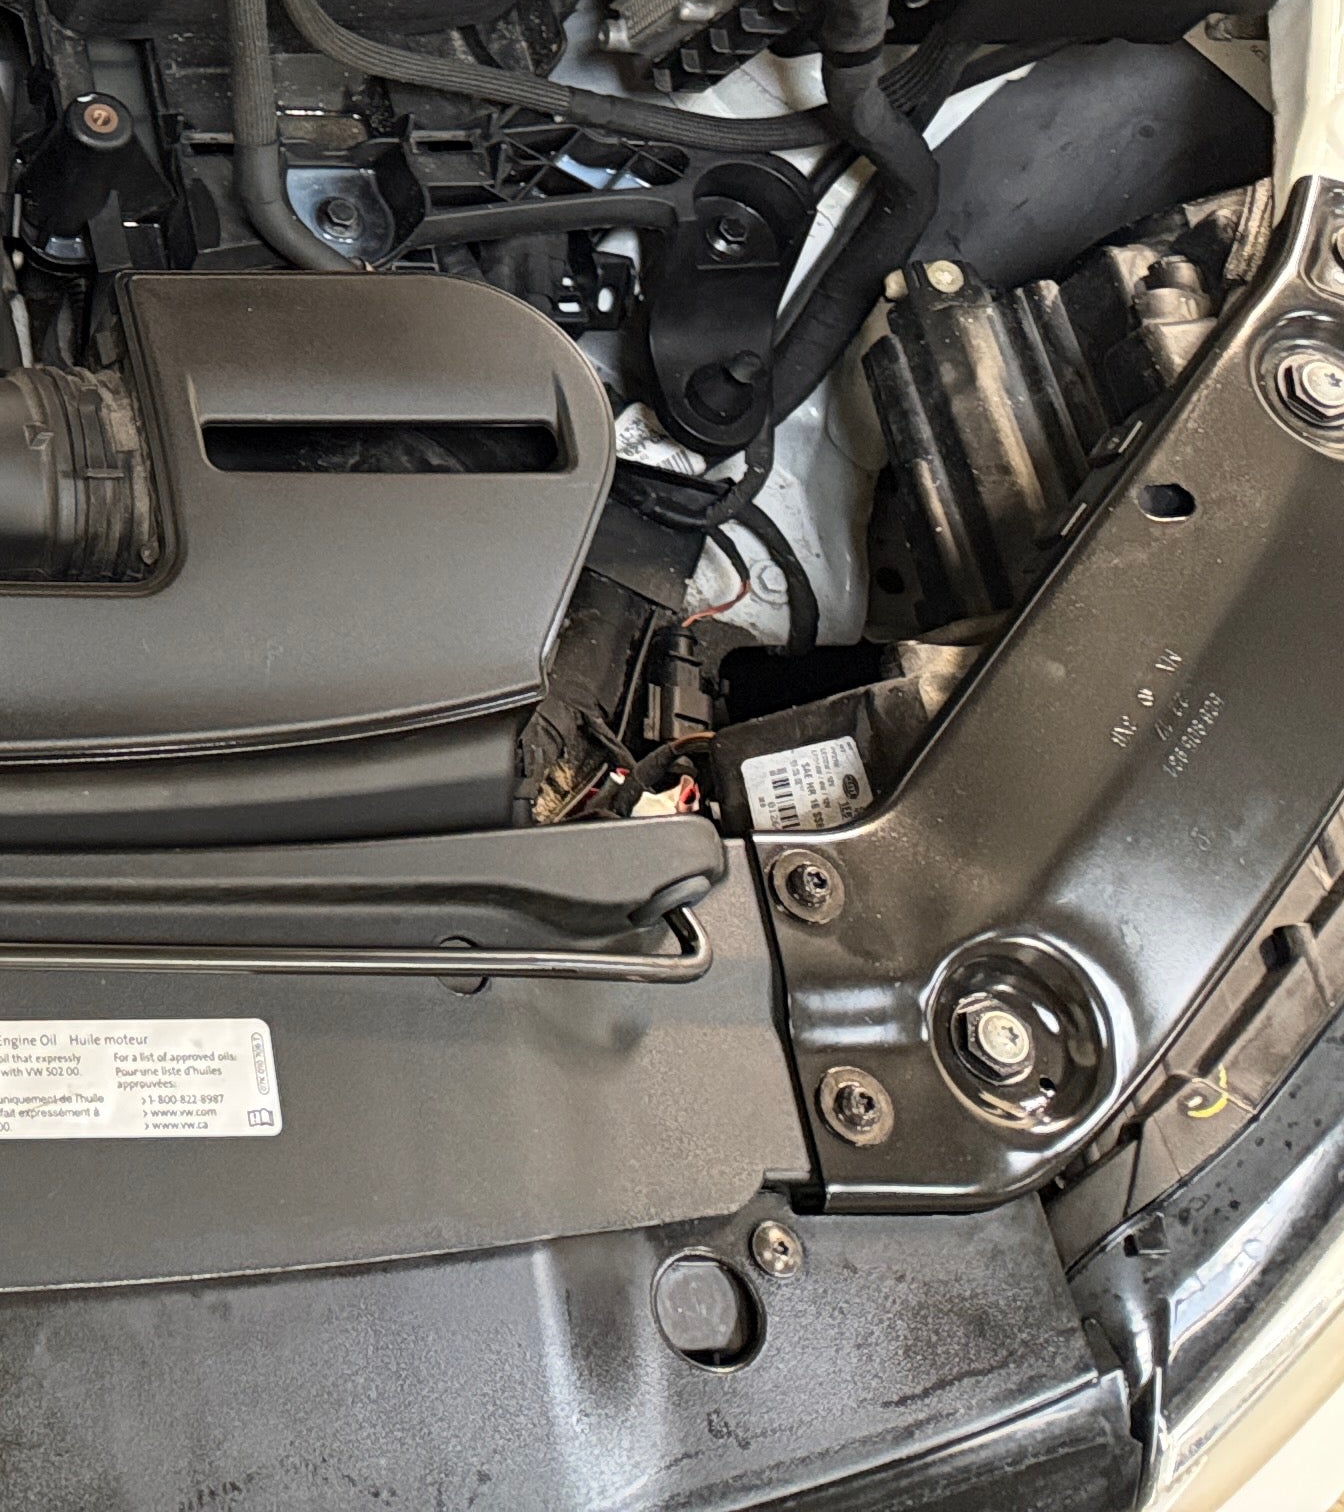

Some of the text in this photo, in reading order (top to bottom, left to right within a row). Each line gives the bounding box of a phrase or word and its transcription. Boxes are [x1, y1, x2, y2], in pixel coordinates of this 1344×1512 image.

[40, 1034, 57, 1046] Oil
[70, 1034, 101, 1046] Huile
[104, 1034, 148, 1046] moteur
[12, 1055, 33, 1063] that
[36, 1054, 81, 1064] expressly
[114, 1053, 128, 1062] For
[131, 1054, 137, 1062] a
[140, 1053, 154, 1062] list
[157, 1052, 167, 1061] of
[170, 1052, 215, 1064] approved
[1, 1067, 23, 1076] with
[26, 1067, 43, 1076] VW
[162, 1066, 181, 1075] liste
[60, 1095, 72, 1103] de
